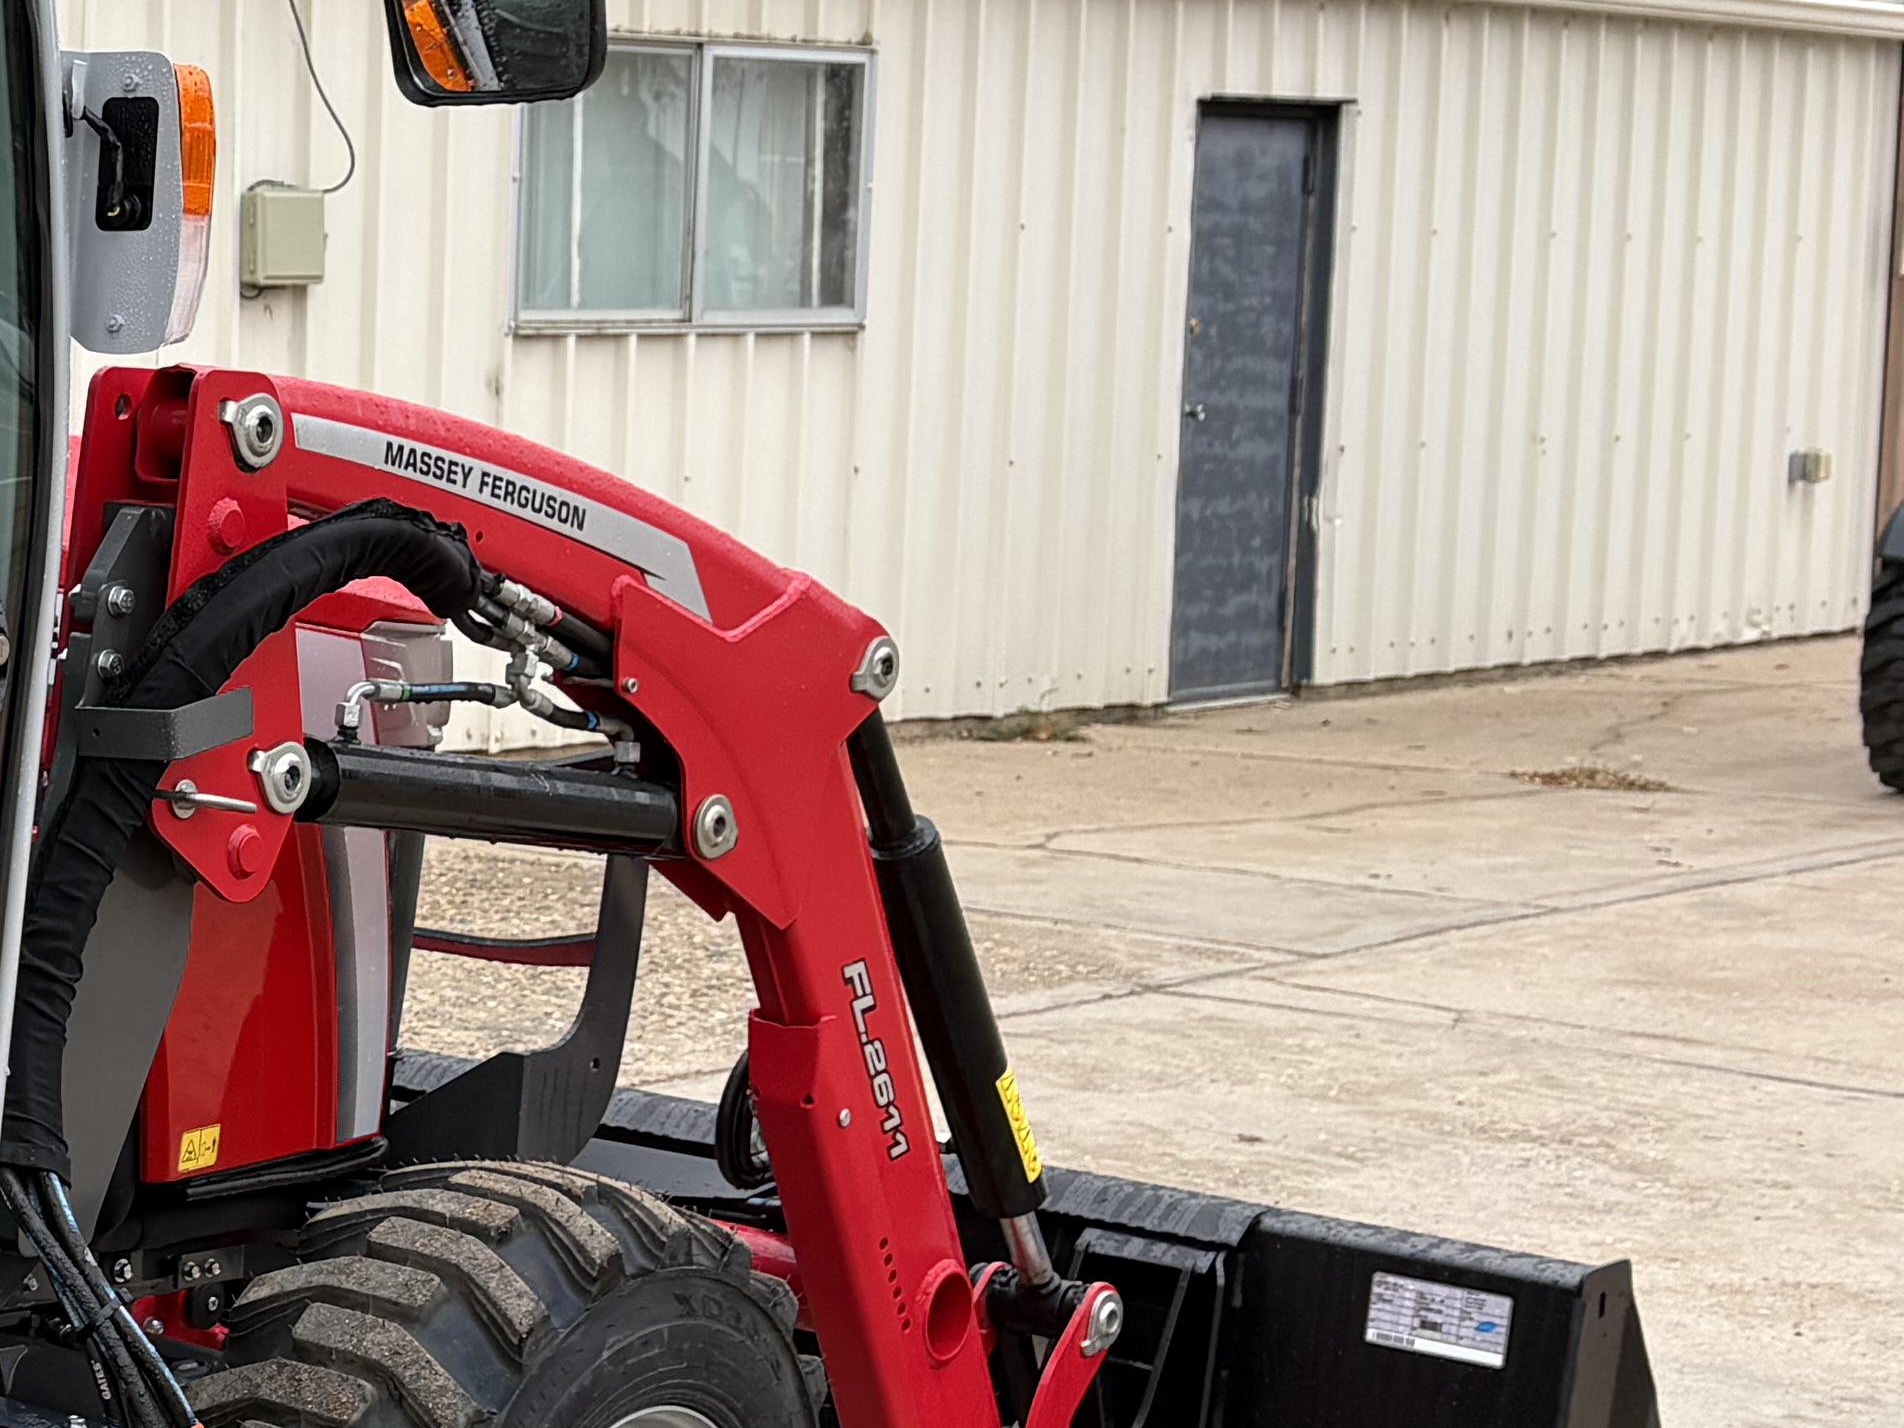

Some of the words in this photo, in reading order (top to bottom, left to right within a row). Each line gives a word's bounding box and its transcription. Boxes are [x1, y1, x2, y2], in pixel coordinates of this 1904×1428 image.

[384, 441, 475, 489] MASSEY
[478, 471, 586, 531] FERGUSON
[842, 958, 910, 1161] FL.2611
